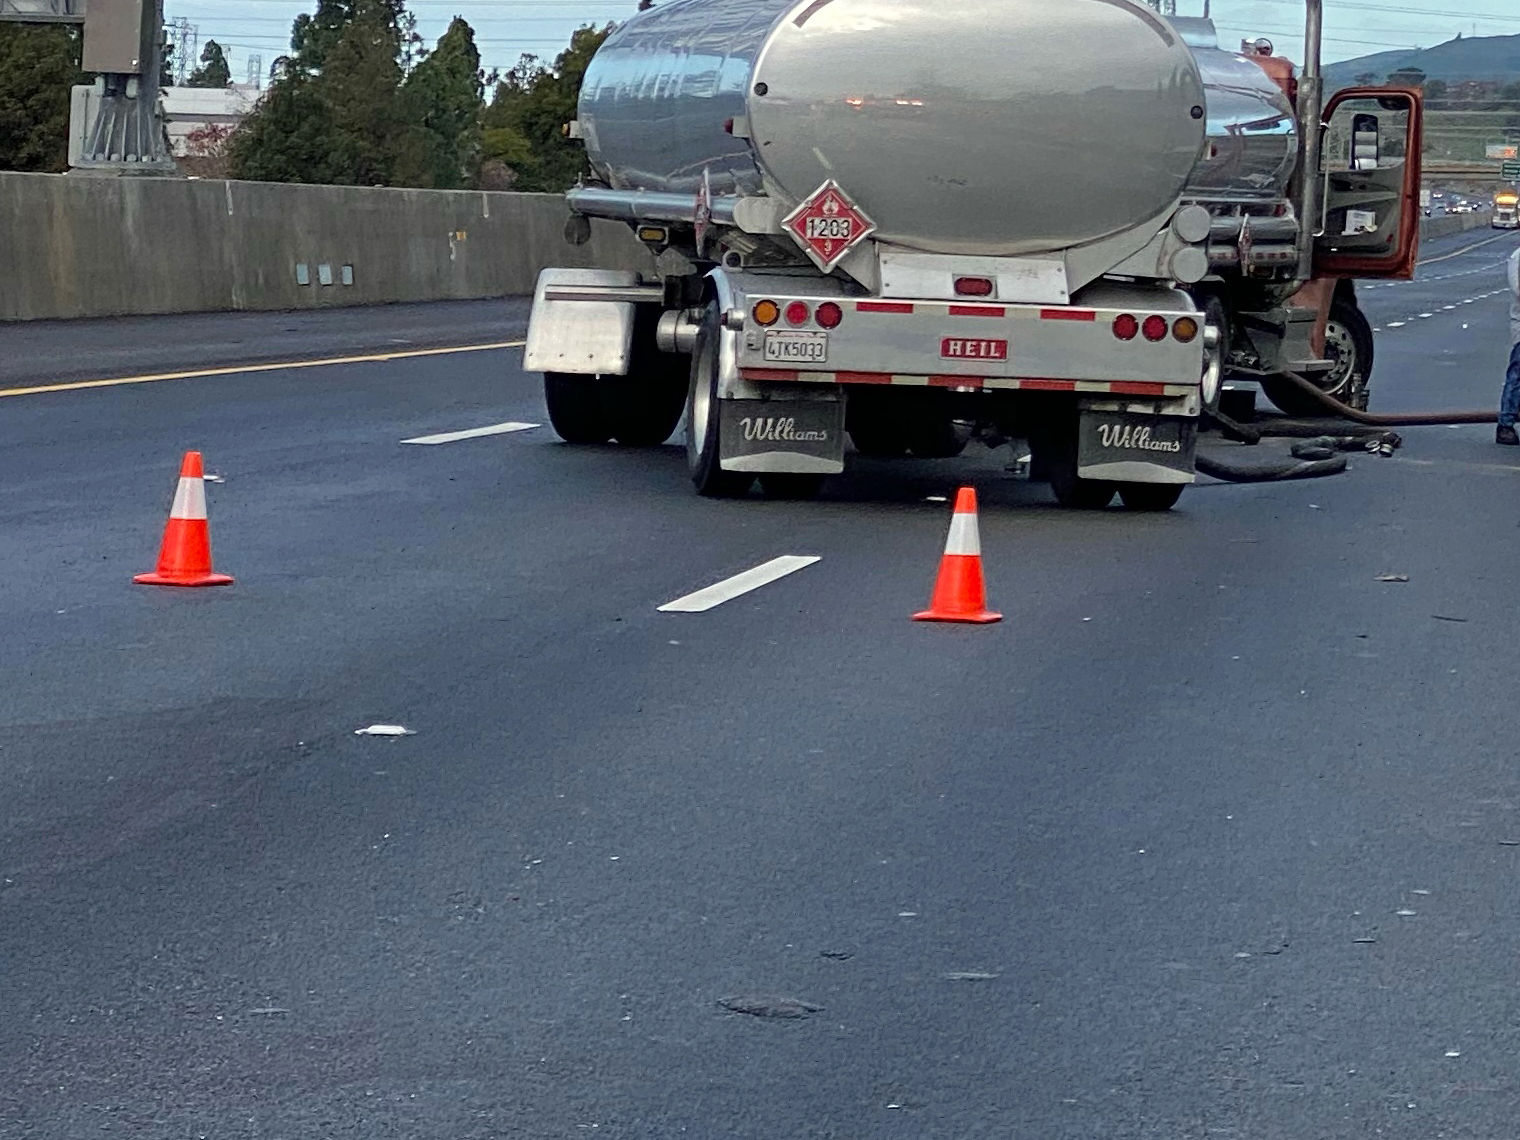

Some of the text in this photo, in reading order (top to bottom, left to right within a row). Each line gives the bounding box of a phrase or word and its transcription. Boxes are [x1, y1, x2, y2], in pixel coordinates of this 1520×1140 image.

[808, 218, 851, 238] 1203
[949, 338, 1001, 357] HEIL
[740, 417, 828, 441] Williams
[1097, 423, 1181, 453] Williams
